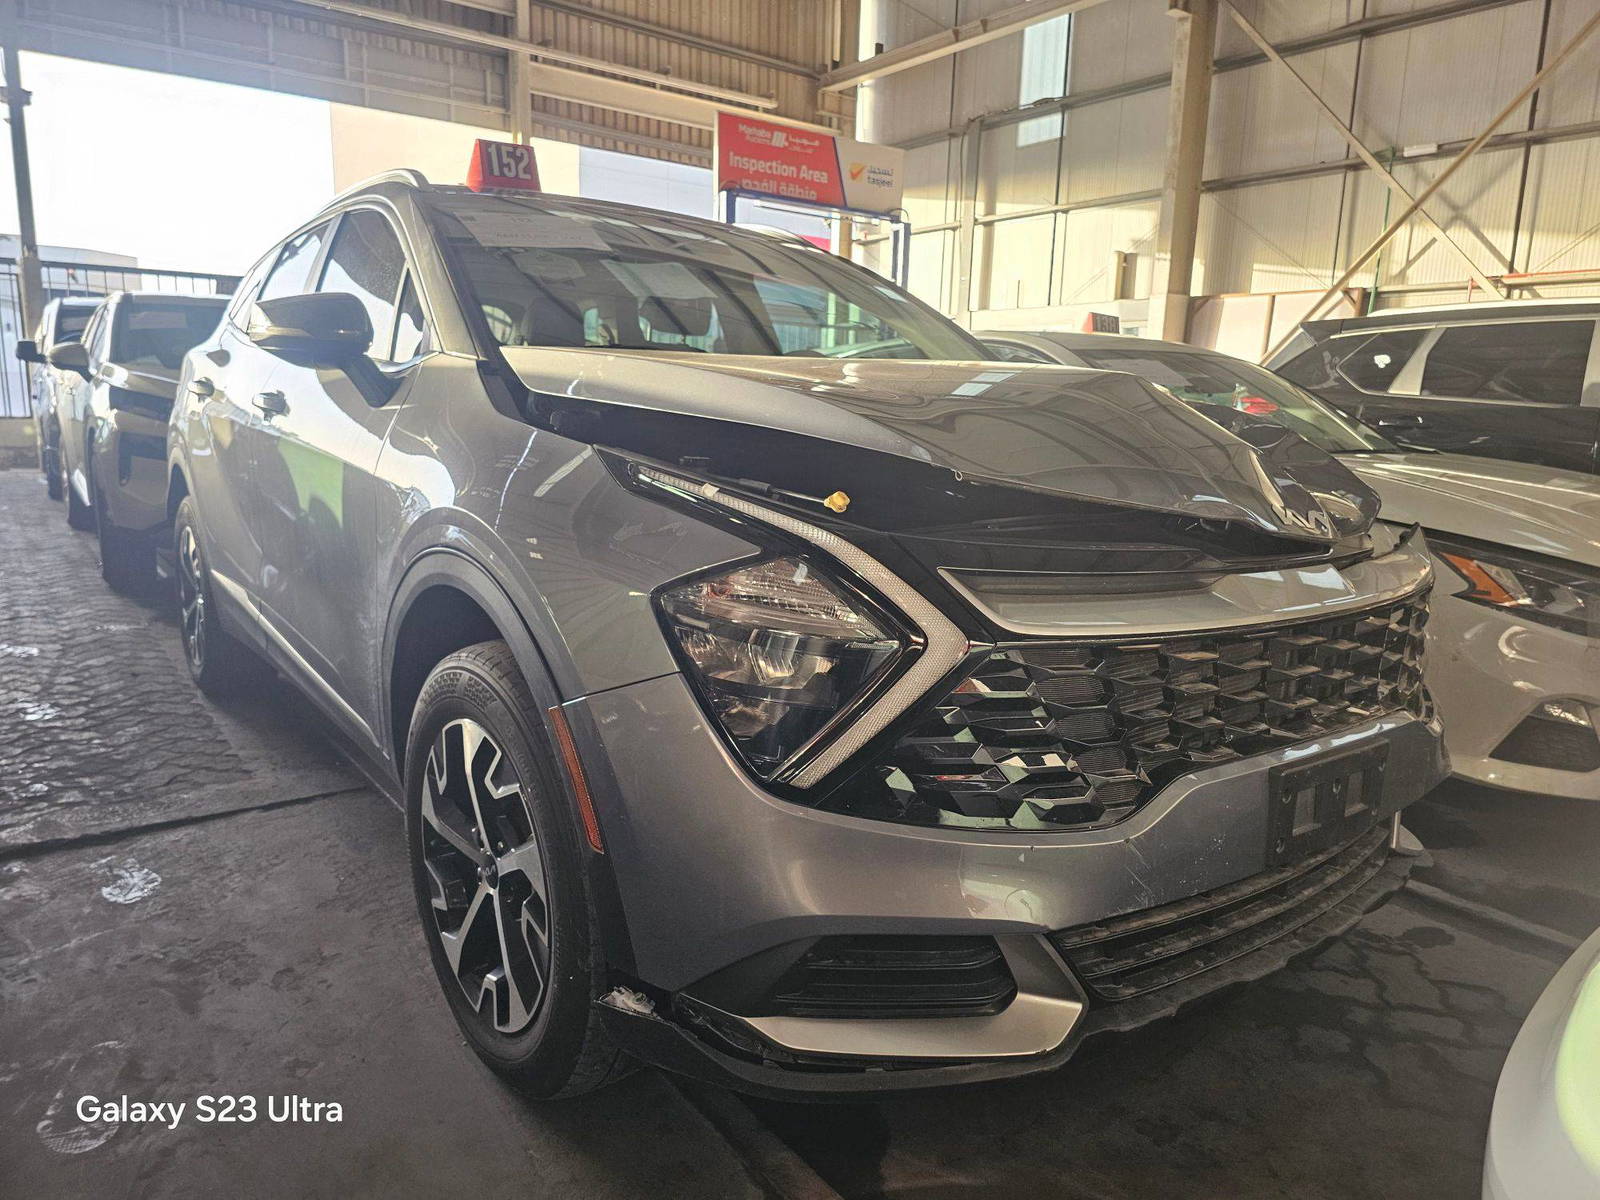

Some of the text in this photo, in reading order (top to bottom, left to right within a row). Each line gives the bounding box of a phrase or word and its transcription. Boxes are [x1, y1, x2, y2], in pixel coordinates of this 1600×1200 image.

[488, 143, 531, 179] 152
[729, 151, 828, 184] Inspection Area
